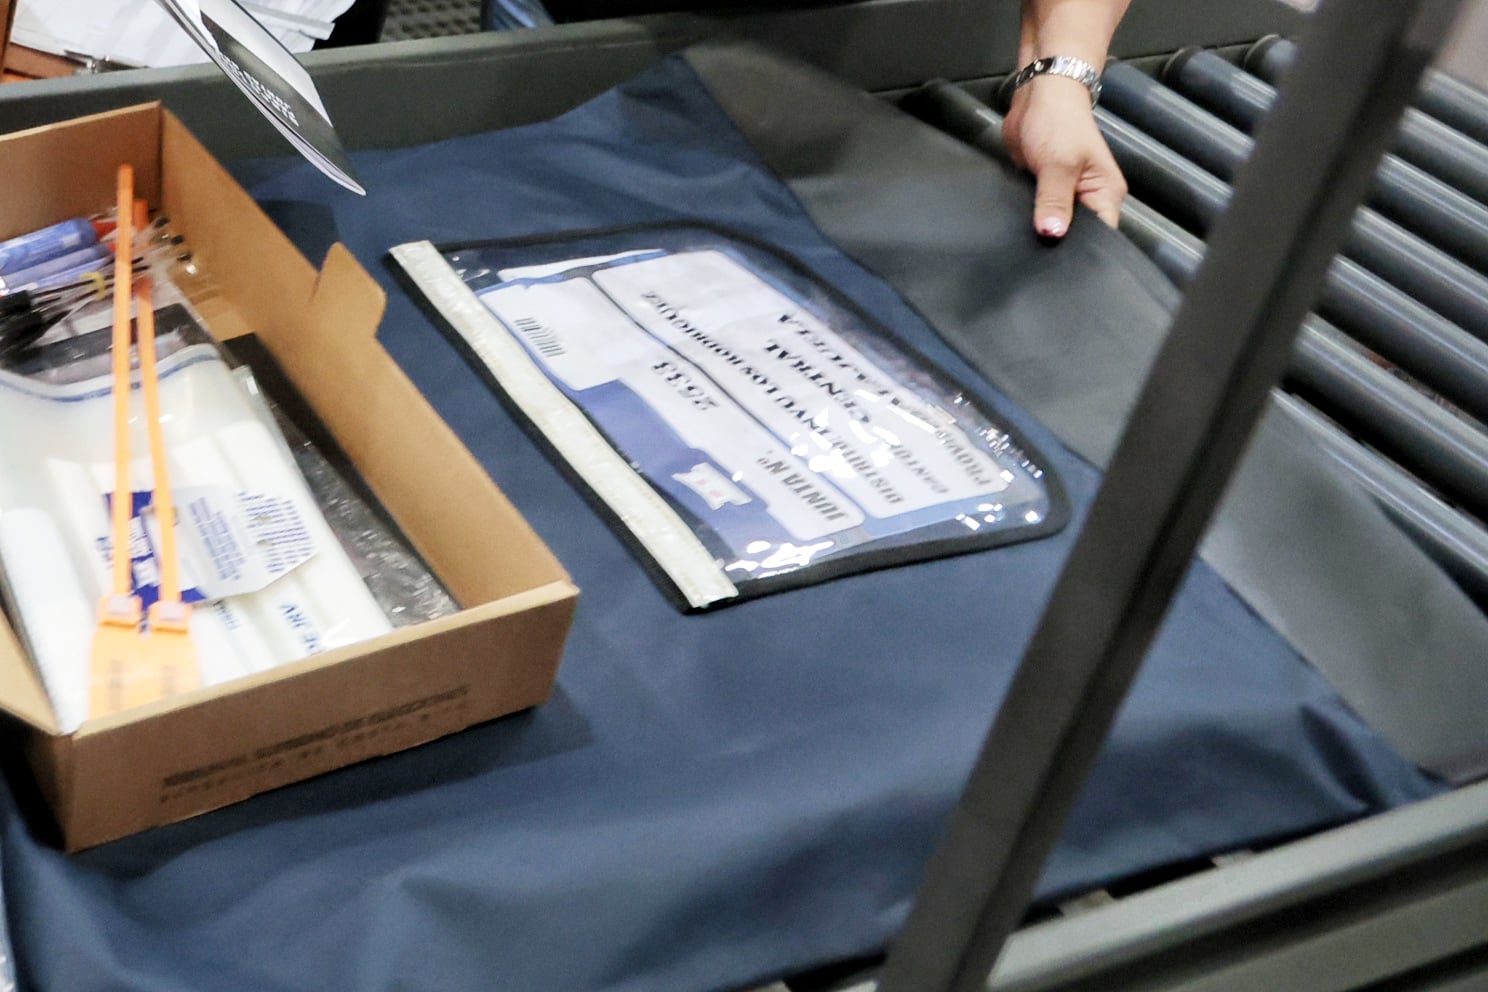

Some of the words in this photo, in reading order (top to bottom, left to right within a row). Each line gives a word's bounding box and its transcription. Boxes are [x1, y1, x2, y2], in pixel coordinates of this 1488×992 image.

[652, 361, 719, 411] 2533
[765, 342, 871, 424] CENTRAL
[782, 473, 849, 522] JUNTA
